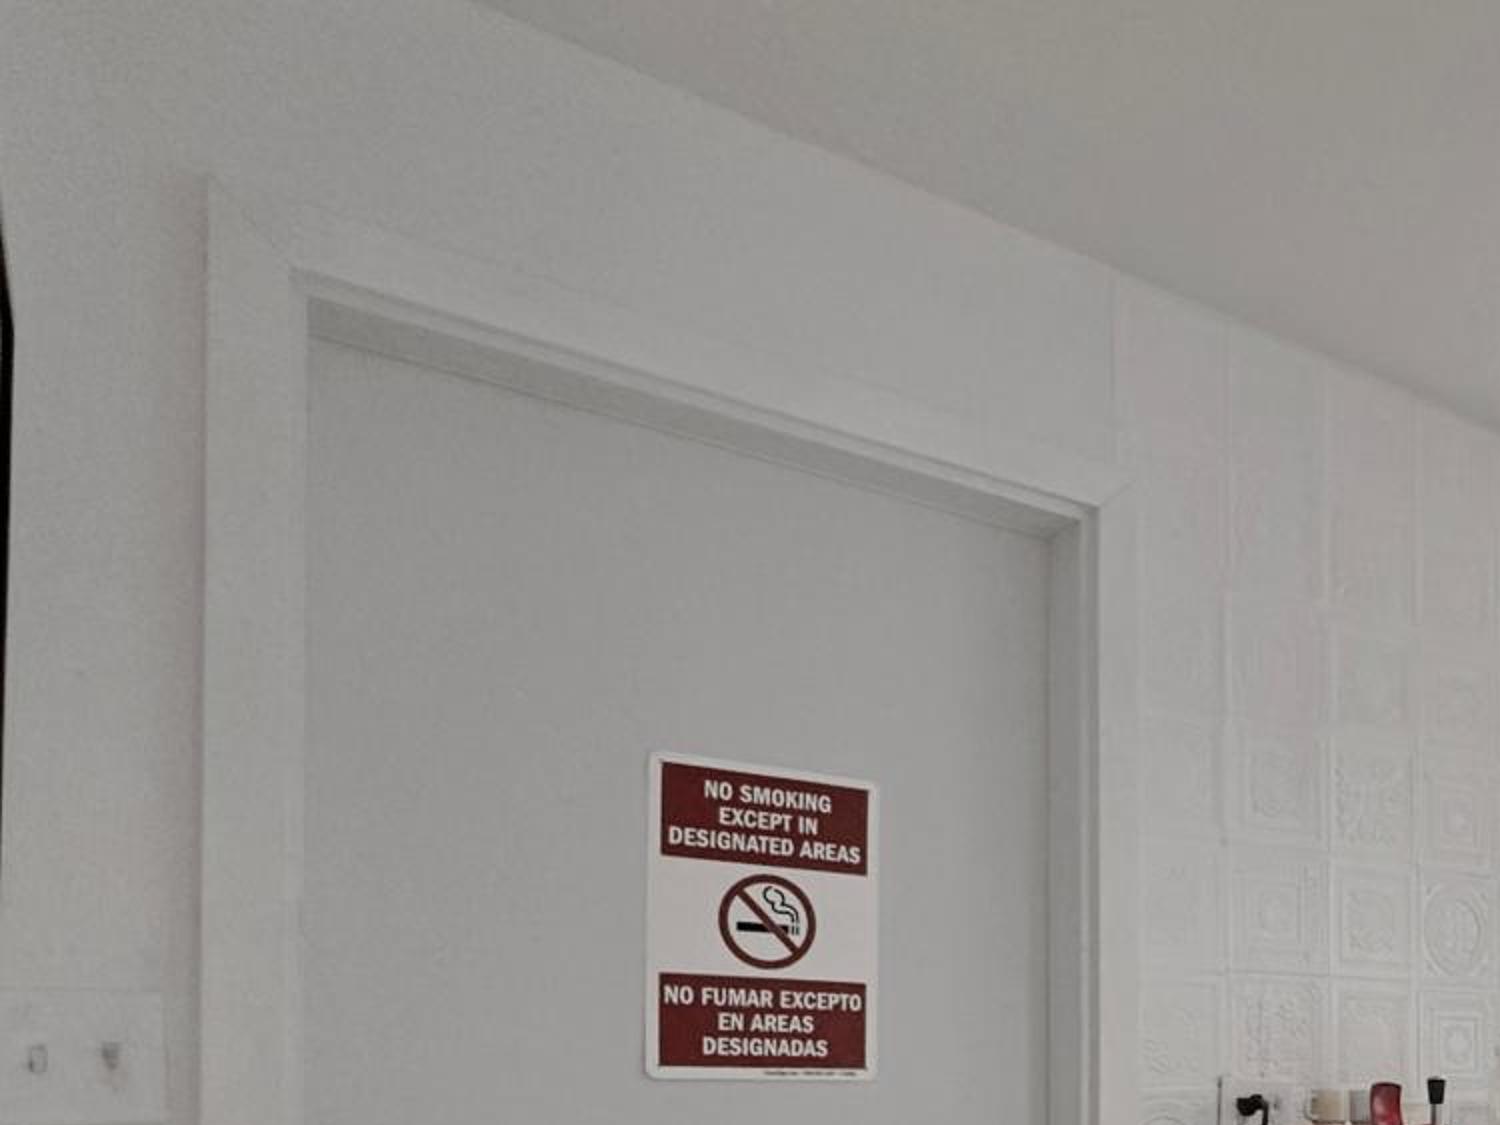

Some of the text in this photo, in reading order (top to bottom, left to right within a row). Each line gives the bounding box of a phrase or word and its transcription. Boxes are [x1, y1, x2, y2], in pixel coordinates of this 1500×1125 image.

[704, 779, 832, 813] NO SMOKING
[719, 807, 818, 836] EXCEPT IN
[668, 825, 861, 864] DESIGNATED AREAS
[663, 984, 862, 1012] NO FUMAR EXCEPTO
[717, 1013, 814, 1033] EN AREAS
[702, 1036, 828, 1058] DESIGNADAS
